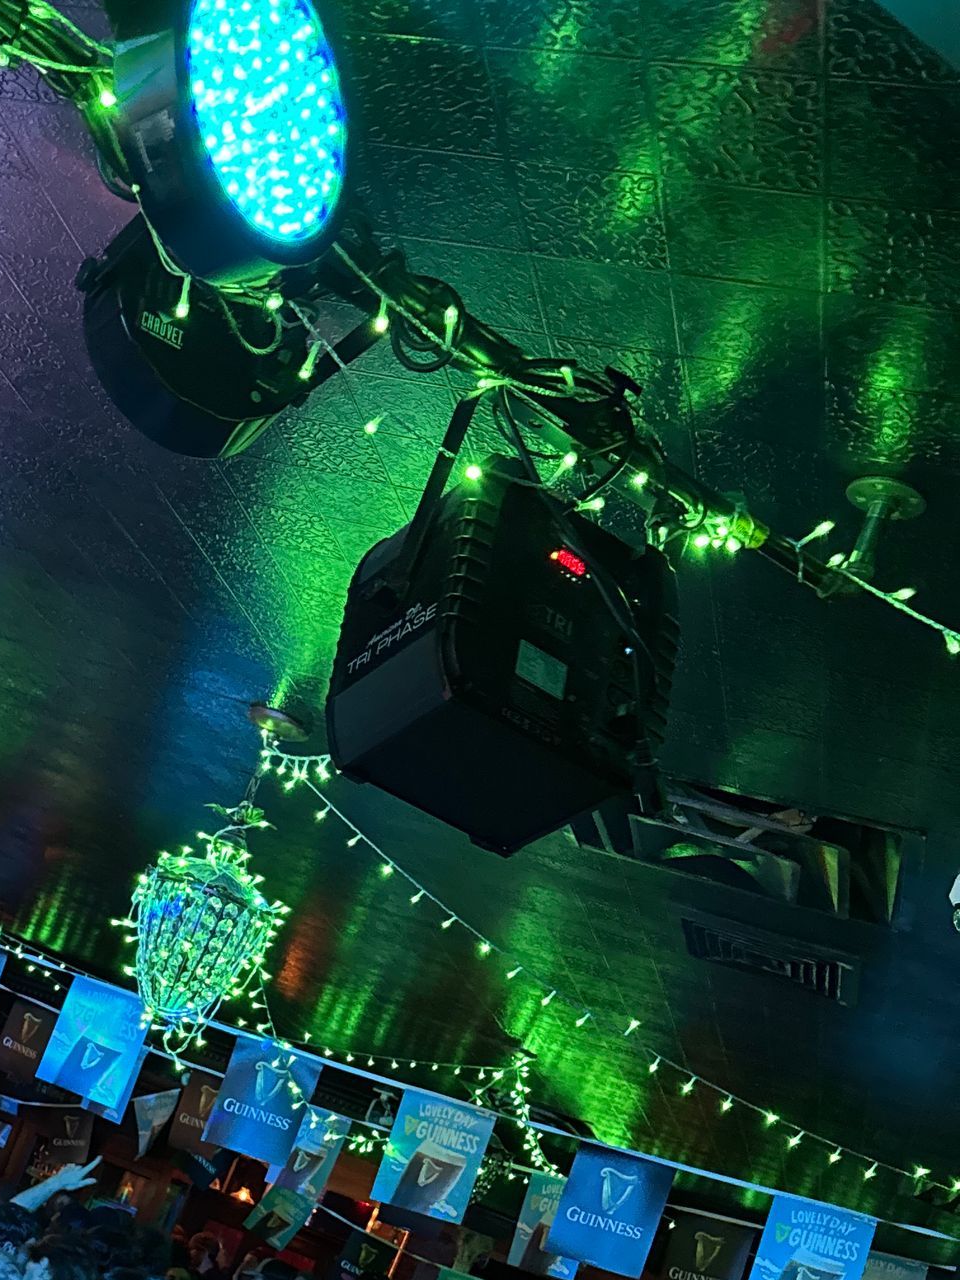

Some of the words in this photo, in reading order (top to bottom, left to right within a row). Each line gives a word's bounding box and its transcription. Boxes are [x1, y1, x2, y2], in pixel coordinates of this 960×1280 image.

[141, 311, 184, 346] CHAUVET
[347, 649, 372, 674] TRI
[376, 602, 438, 655] PHASE
[223, 1097, 292, 1131] GUINNESS
[419, 1103, 454, 1120] LOVELY
[453, 1110, 478, 1128] DAY
[416, 1121, 480, 1154] GUINNESS
[566, 1205, 644, 1239] GUINNESS
[791, 1210, 831, 1226] LOVELY
[829, 1216, 857, 1235] DAY
[788, 1228, 860, 1262] GUINNESS
